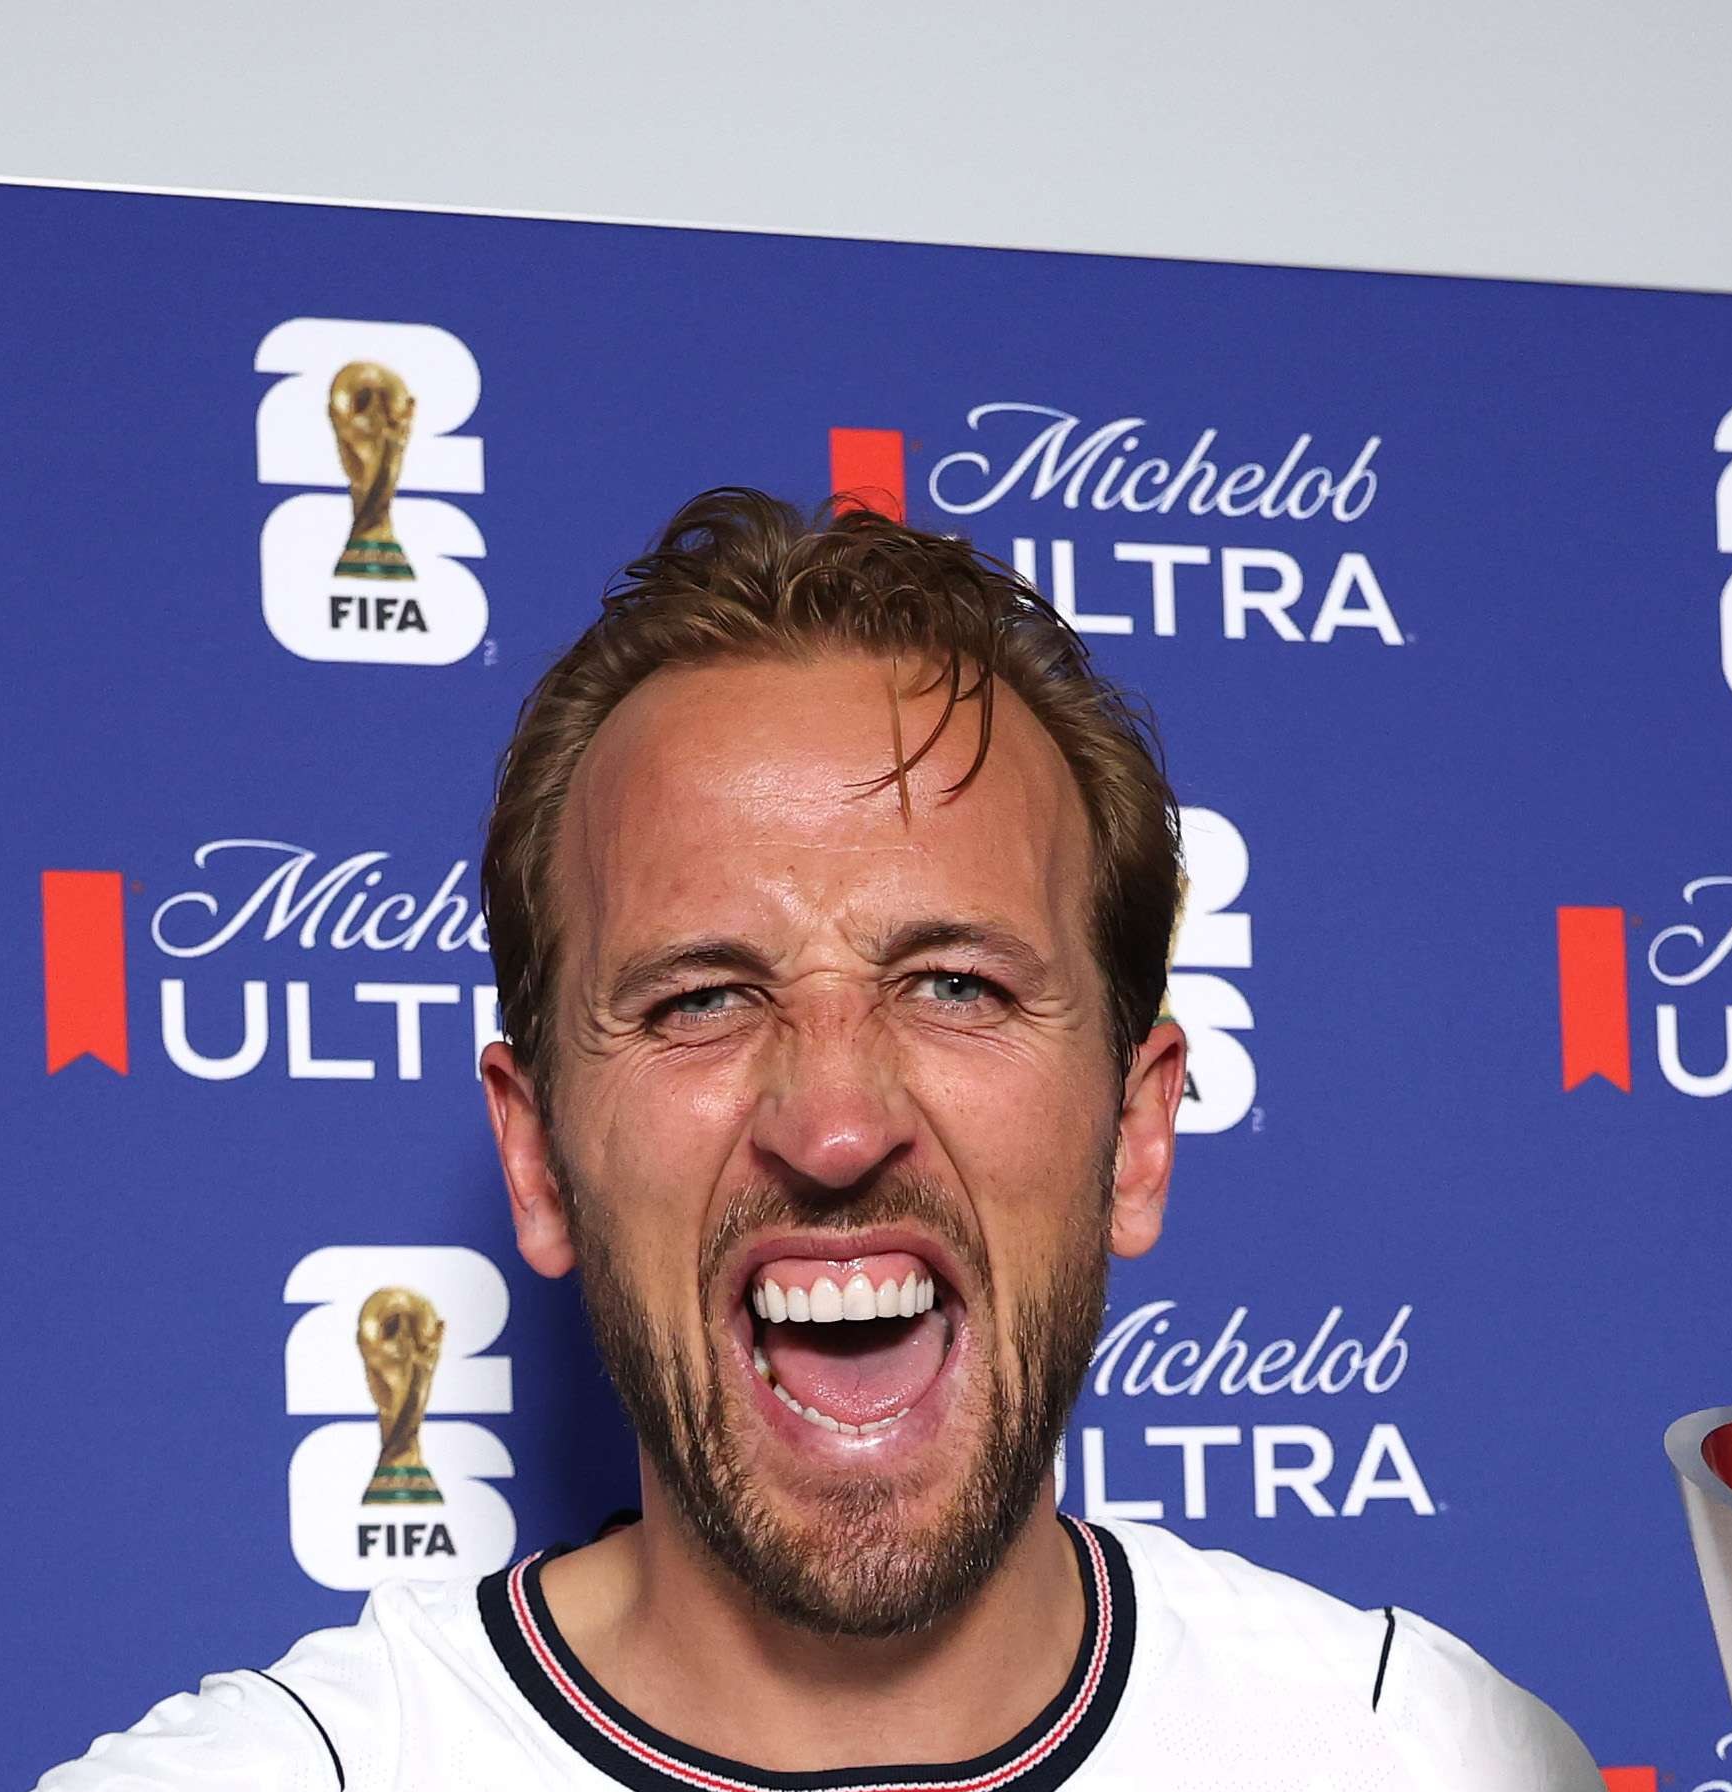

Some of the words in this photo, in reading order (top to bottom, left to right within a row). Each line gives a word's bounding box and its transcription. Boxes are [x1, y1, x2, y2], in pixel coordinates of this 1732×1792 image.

[927, 402, 1382, 523] Michelob
[329, 595, 429, 633] FIFA
[160, 978, 505, 1081] ULT
[1054, 1423, 1437, 1521] LTRA
[357, 1523, 457, 1558] FIFA
